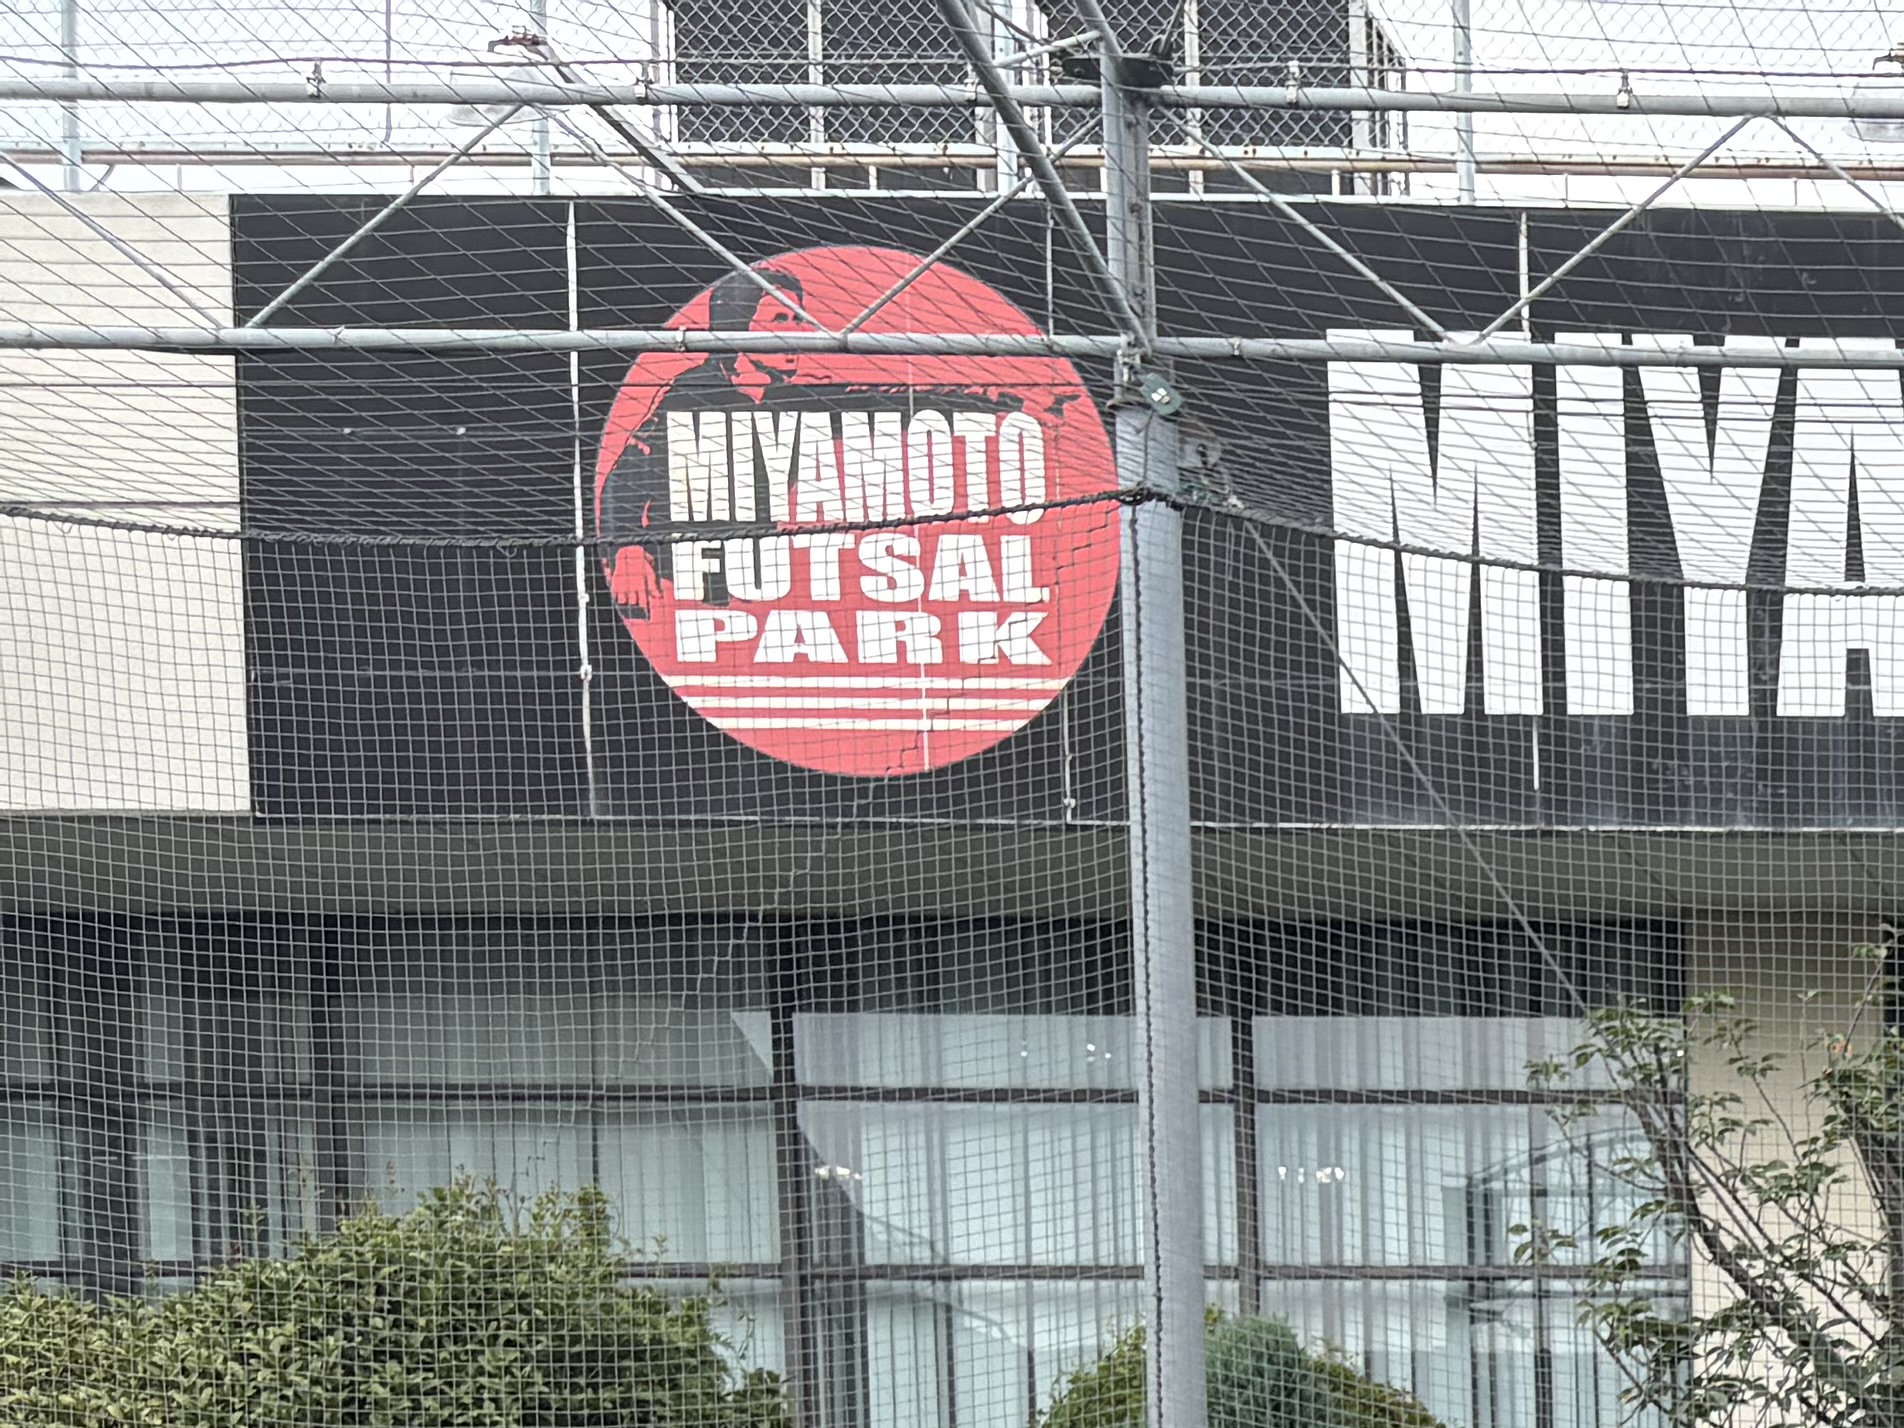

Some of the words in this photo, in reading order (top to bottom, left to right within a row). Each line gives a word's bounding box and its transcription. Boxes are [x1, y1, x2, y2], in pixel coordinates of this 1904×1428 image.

[666, 409, 1045, 526] MIYAMOTO
[672, 533, 1050, 603] FUTSAL
[675, 609, 1052, 665] PARK
